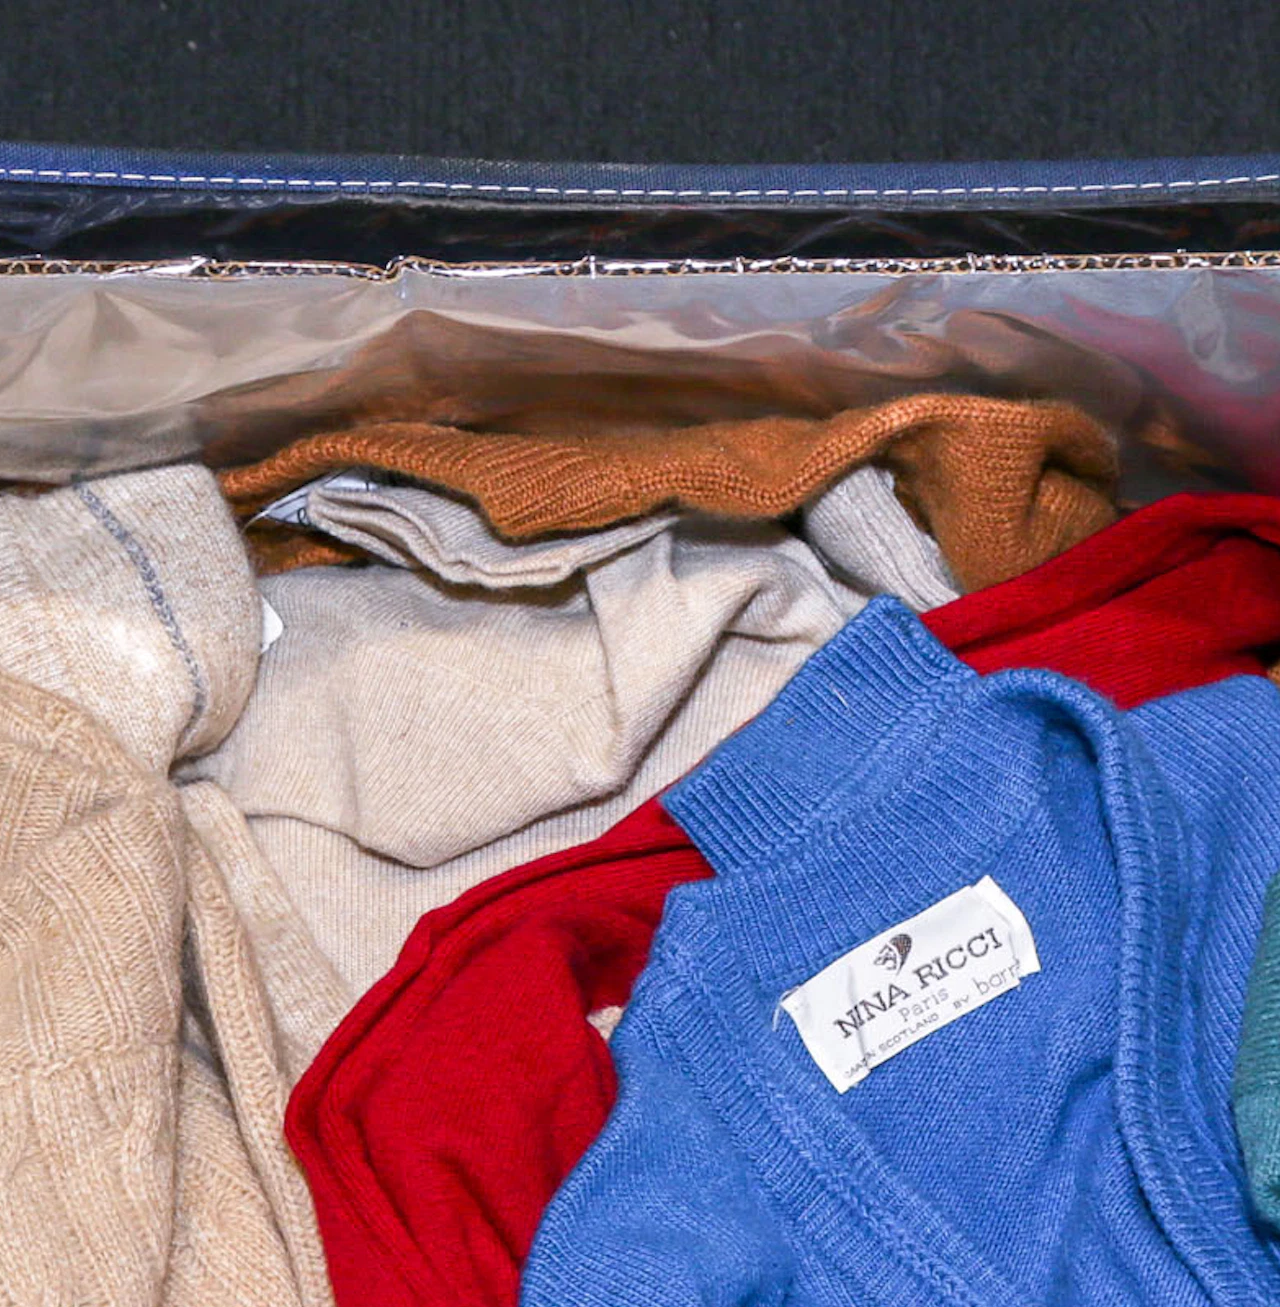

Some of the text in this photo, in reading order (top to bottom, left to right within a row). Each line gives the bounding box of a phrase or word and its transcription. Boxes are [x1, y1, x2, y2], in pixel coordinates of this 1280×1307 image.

[833, 927, 1003, 1038] NINA RICCI
[899, 988, 949, 1023] Paris
[878, 1012, 939, 1052] SCOTLAND
